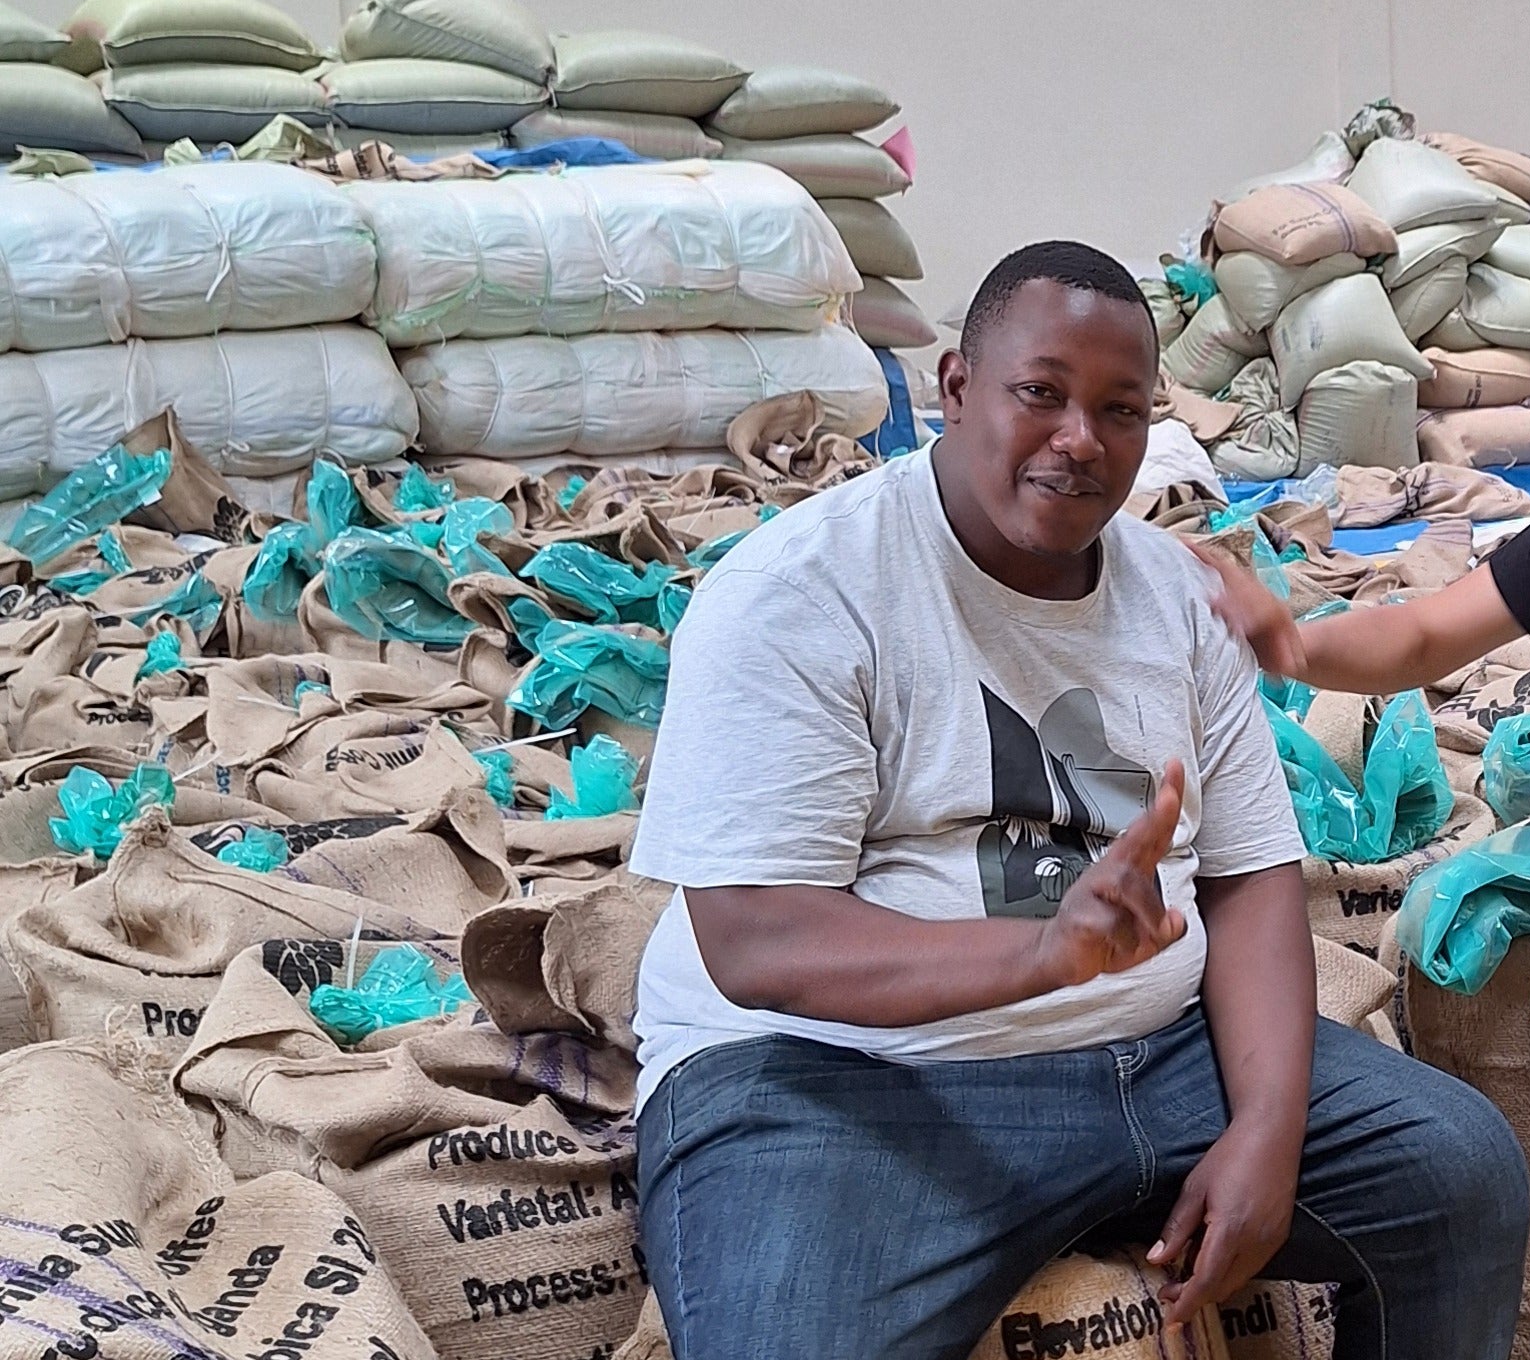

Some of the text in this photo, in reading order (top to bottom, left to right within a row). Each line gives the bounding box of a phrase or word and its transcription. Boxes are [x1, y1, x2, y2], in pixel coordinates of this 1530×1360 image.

[427, 1122, 580, 1171] Produce
[437, 1179, 603, 1244] Varietal:
[461, 1258, 628, 1323] Process:
